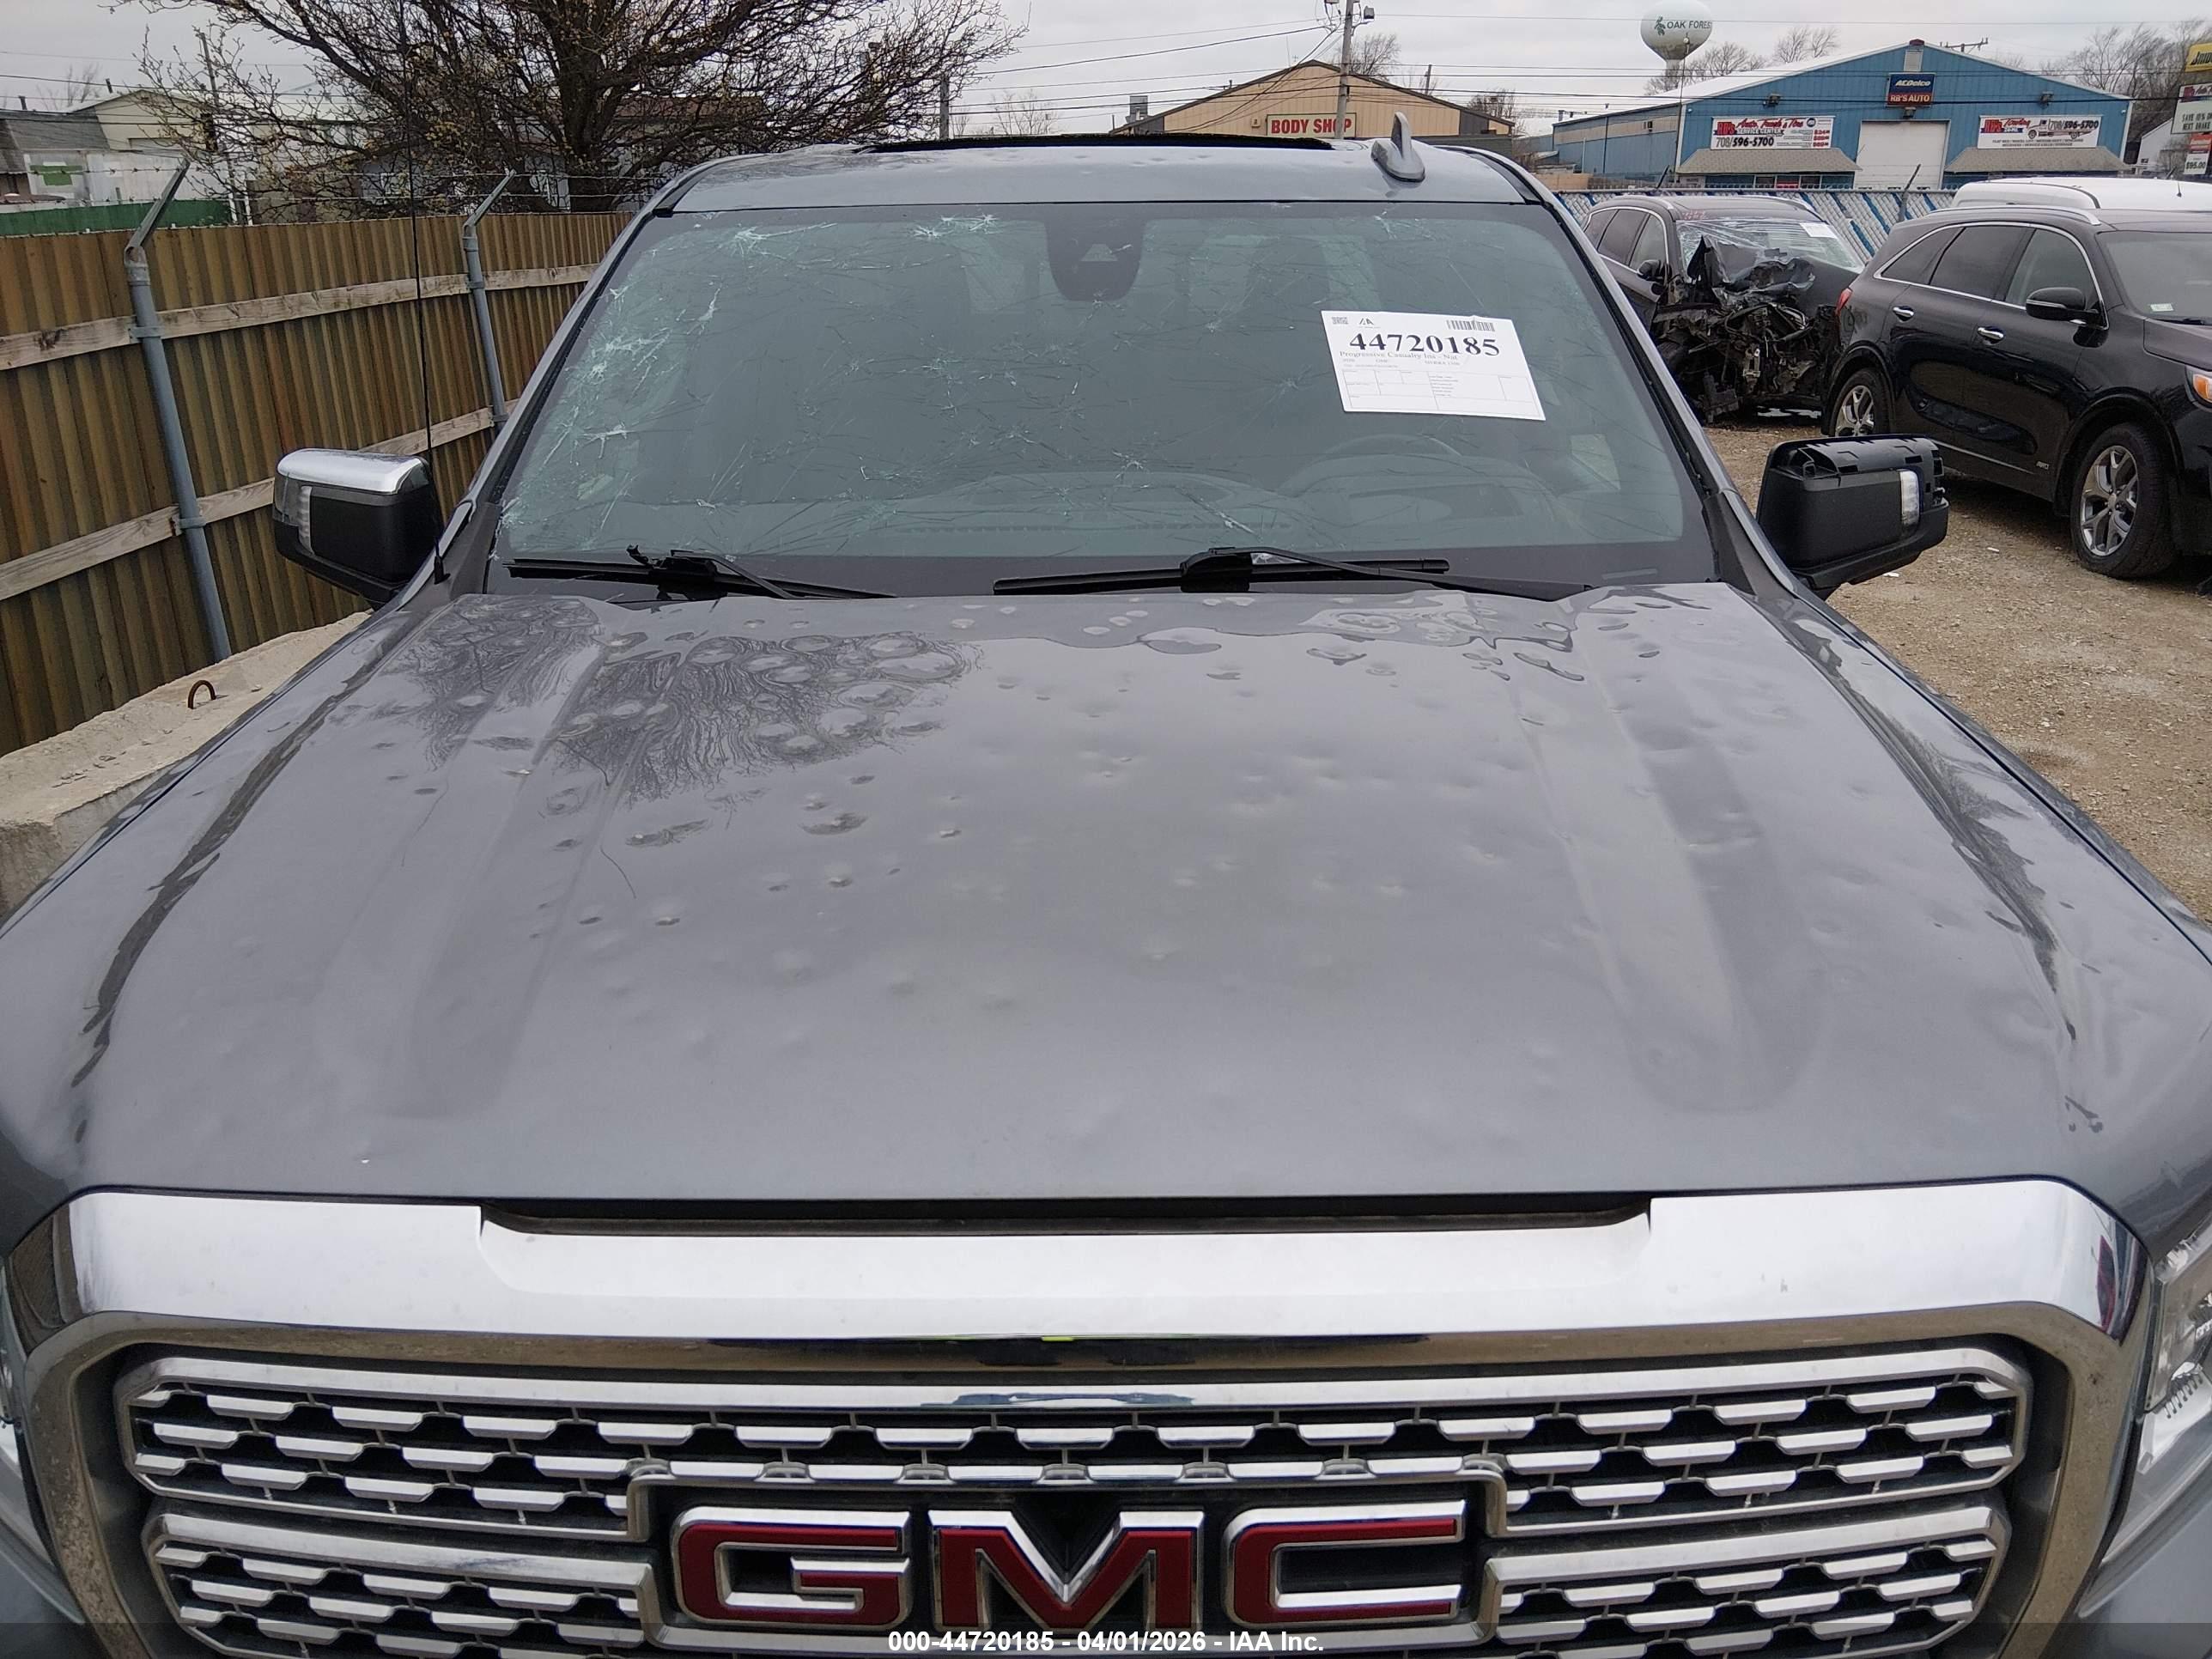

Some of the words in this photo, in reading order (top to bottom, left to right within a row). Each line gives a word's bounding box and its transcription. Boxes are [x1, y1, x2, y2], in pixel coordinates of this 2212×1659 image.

[1667, 21, 1686, 29] OAK
[2182, 113, 2195, 122] SAVE
[1271, 119, 1310, 134] BODY
[1313, 118, 1352, 133] SHP
[2001, 118, 2031, 129] Towing
[1349, 332, 1500, 356] 44720185
[1387, 351, 1421, 360] Casualty
[672, 1498, 1468, 1632] GMC
